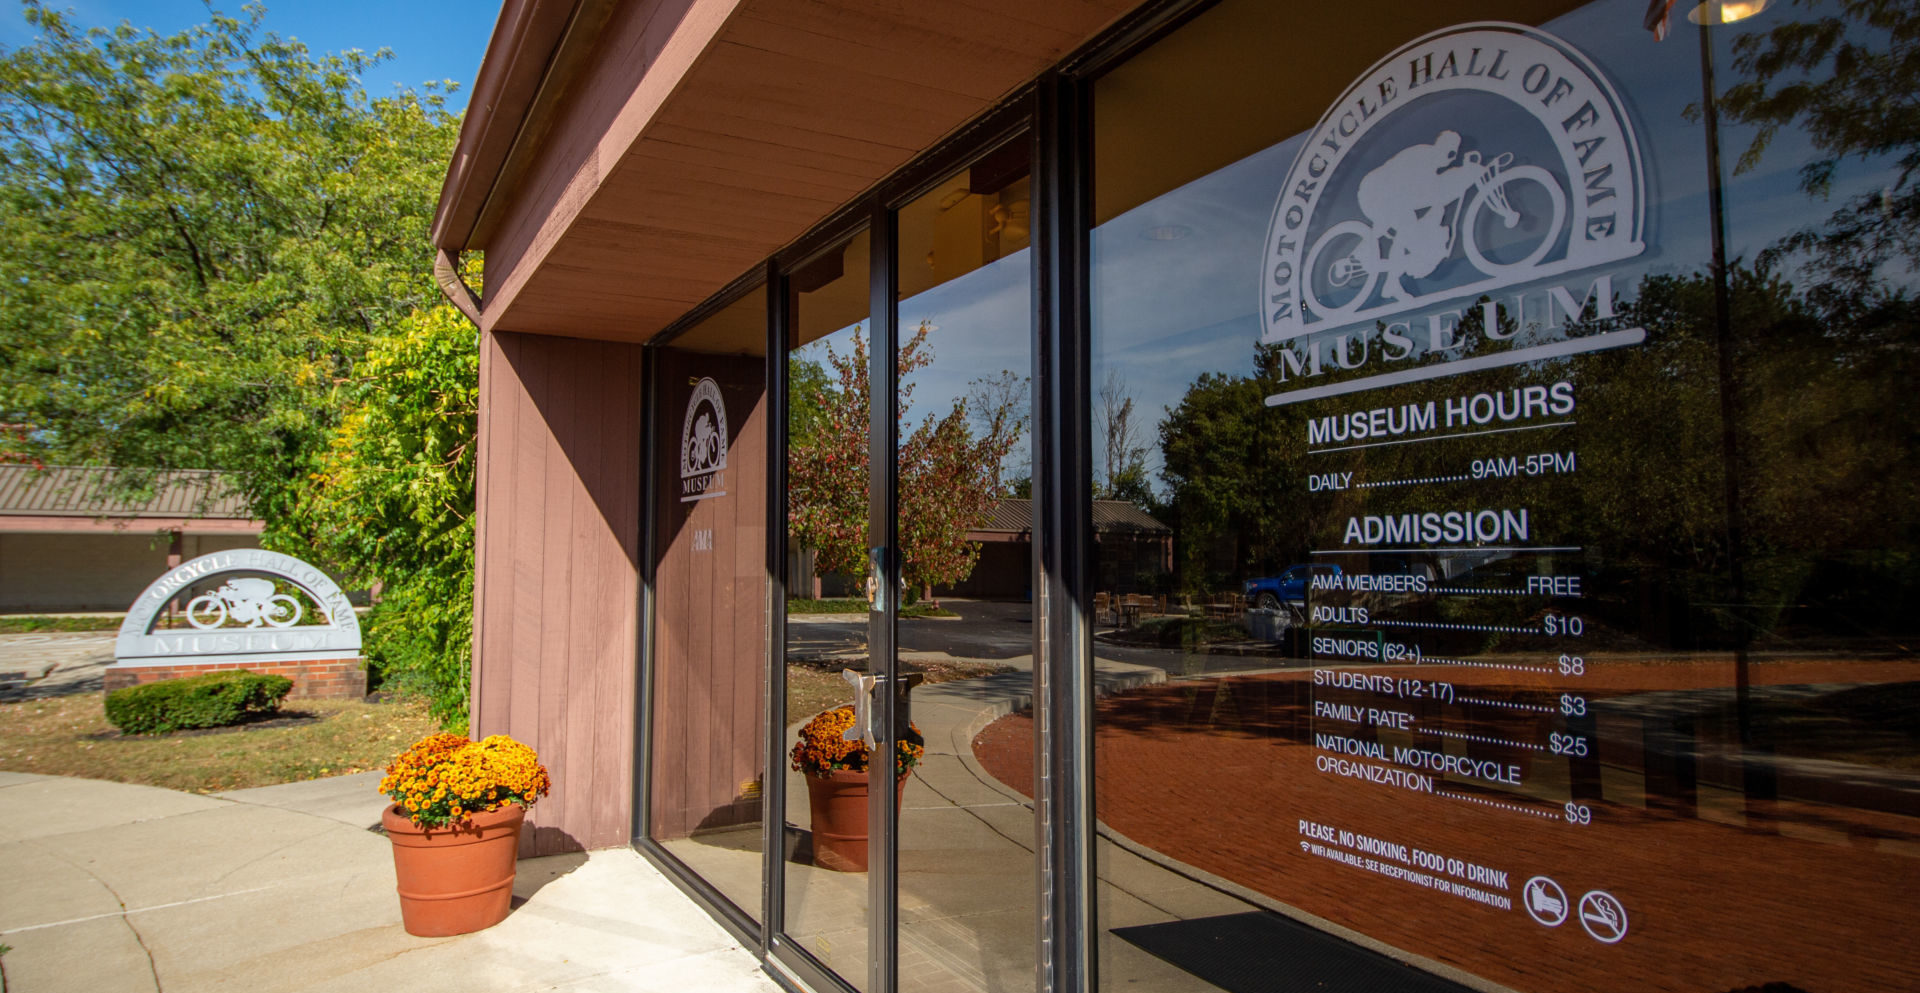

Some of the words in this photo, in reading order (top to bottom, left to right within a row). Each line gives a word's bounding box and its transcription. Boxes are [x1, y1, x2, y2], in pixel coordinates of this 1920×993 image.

[1273, 77, 1398, 324] MOTORCYCLE
[1407, 47, 1511, 90] HALL
[1522, 62, 1574, 108] OF
[1561, 101, 1618, 242] FAME
[1277, 274, 1624, 385] MUSEUM
[1307, 401, 1436, 444] MUSEUM
[1446, 381, 1576, 427] HOURS
[682, 472, 725, 495] MUSEUM
[1308, 471, 1353, 492] DAILY
[1471, 452, 1576, 480] 9AM-5PM
[1343, 508, 1529, 545] ADMISSION
[249, 551, 299, 577] HALL
[303, 570, 328, 589] OF
[326, 590, 356, 633] FAME
[1311, 574, 1344, 592] AMA
[1346, 575, 1427, 593] MEMBERS
[1527, 576, 1582, 597] FREE
[153, 632, 330, 655] MUSEUM
[1312, 607, 1369, 624] ADULTS
[1544, 613, 1583, 636] $10
[1313, 637, 1379, 658] SENIORS
[1382, 642, 1422, 664] (62+)
[1558, 654, 1585, 676] $8
[1314, 669, 1394, 694] STUDENTS
[1398, 678, 1455, 705] (12-17)
[1560, 693, 1586, 717] $3
[1315, 701, 1365, 723] FAMILY
[1549, 731, 1588, 757] $25
[1315, 733, 1391, 762] NATIONAL
[1393, 746, 1522, 786] MOTORCYCLE
[1316, 755, 1433, 793] ORGANIZATION
[1565, 801, 1592, 825] $9
[1299, 819, 1338, 845] PLEASE,
[1339, 830, 1355, 848] NO
[1356, 834, 1411, 865] SMOKING,
[1412, 848, 1444, 873] FOOD
[1447, 858, 1465, 878] OR
[1467, 863, 1509, 890] DRINK
[1311, 843, 1326, 856] WIFI
[1326, 846, 1364, 869] AVAILABLE:
[1365, 859, 1379, 873] SEE
[1380, 863, 1434, 888] RECEPTIONIST
[1434, 878, 1451, 893] FOR
[1451, 883, 1512, 910] INFORMATION
